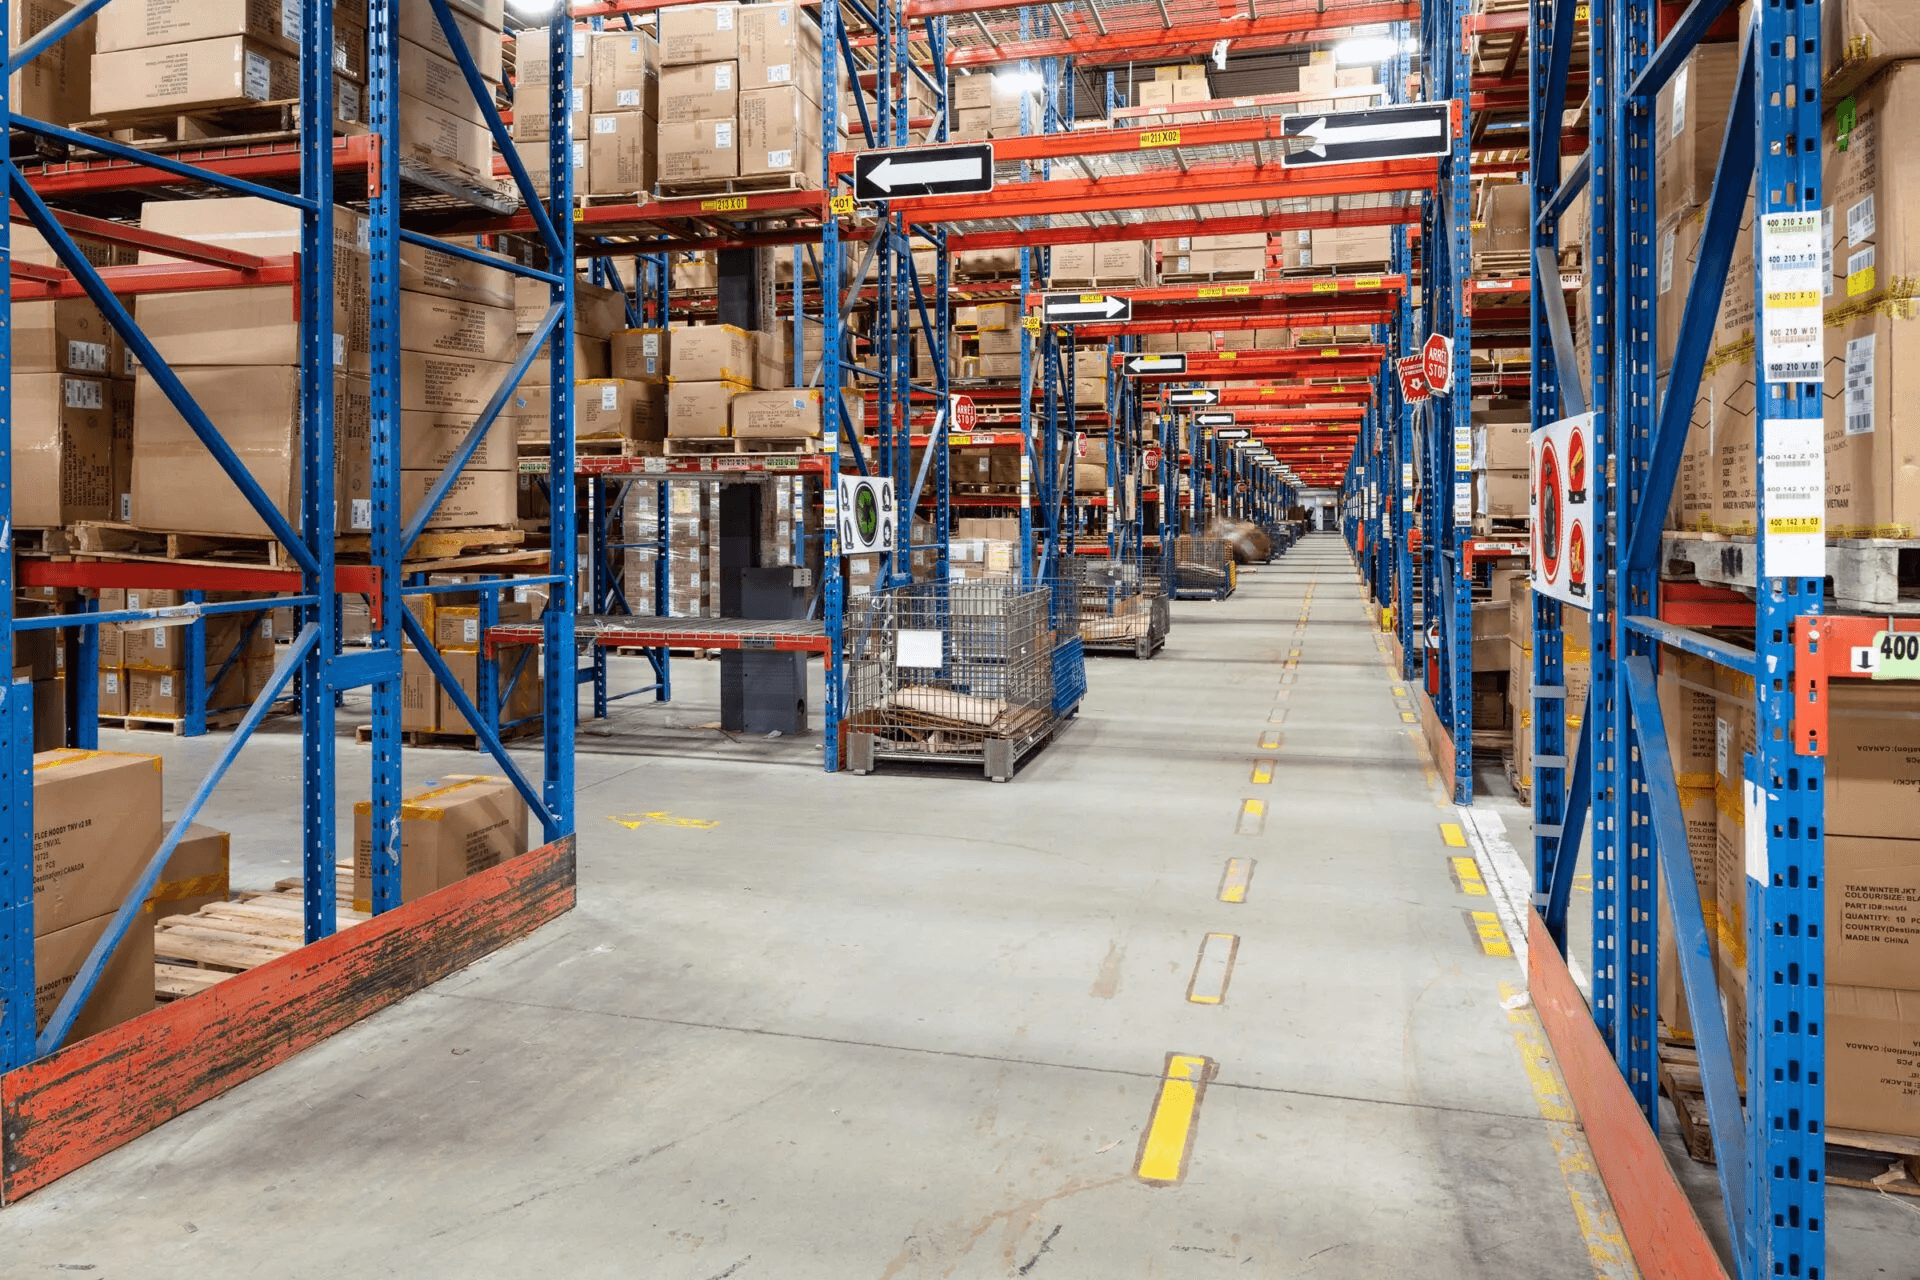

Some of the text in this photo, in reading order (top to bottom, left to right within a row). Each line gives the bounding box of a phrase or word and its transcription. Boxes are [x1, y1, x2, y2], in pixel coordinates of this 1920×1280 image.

[834, 198, 848, 208] 401
[1429, 363, 1447, 379] STOP
[958, 415, 974, 424] STOP
[1880, 636, 1919, 660] 400
[34, 831, 48, 840] FLCE
[49, 826, 66, 836] HOODY
[67, 823, 78, 831] TNV
[45, 860, 56, 869] PCS
[64, 862, 84, 874] CANADA
[1845, 892, 1904, 900] COLOUR/SIZE:
[1845, 913, 1890, 921] QUANTITY:
[1846, 1042, 1879, 1051] CANADA
